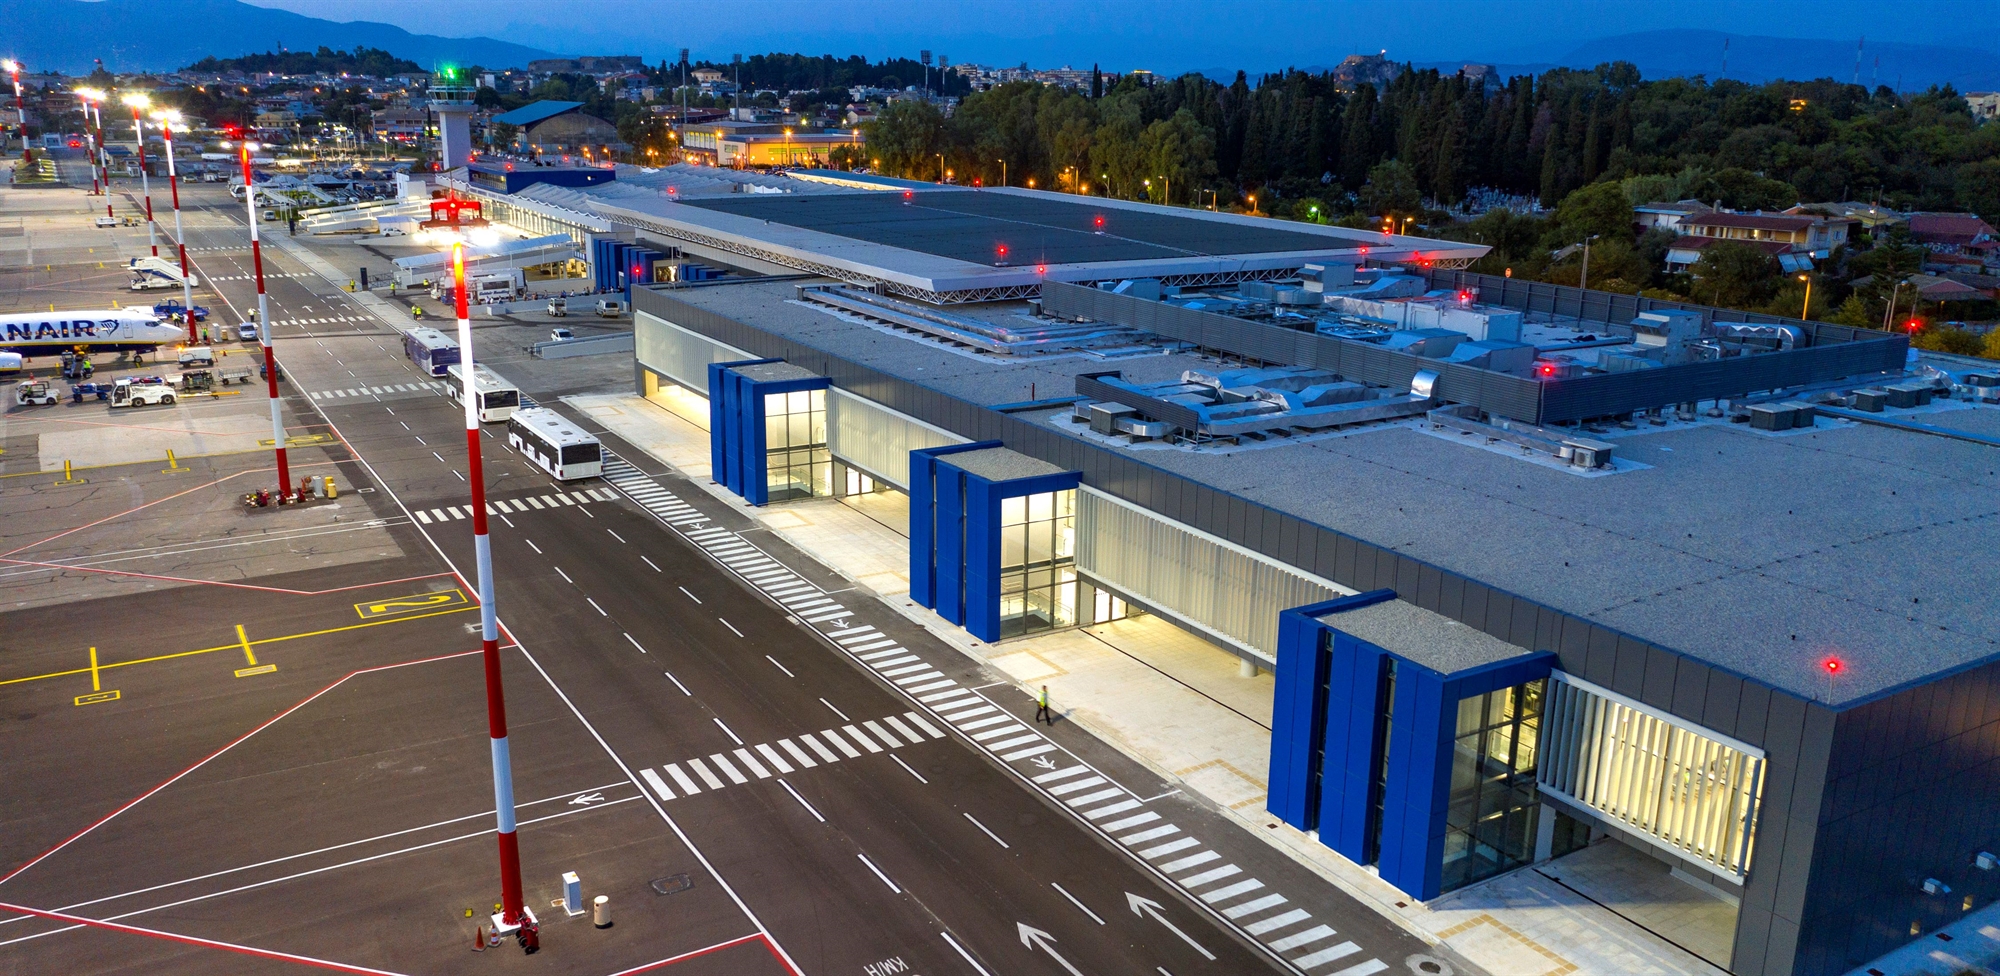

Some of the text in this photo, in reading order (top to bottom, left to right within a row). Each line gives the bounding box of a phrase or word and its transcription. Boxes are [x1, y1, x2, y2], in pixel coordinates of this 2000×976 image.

[0, 320, 98, 342] NAIR
[369, 595, 452, 613] 2
[863, 956, 909, 976] KM/H
